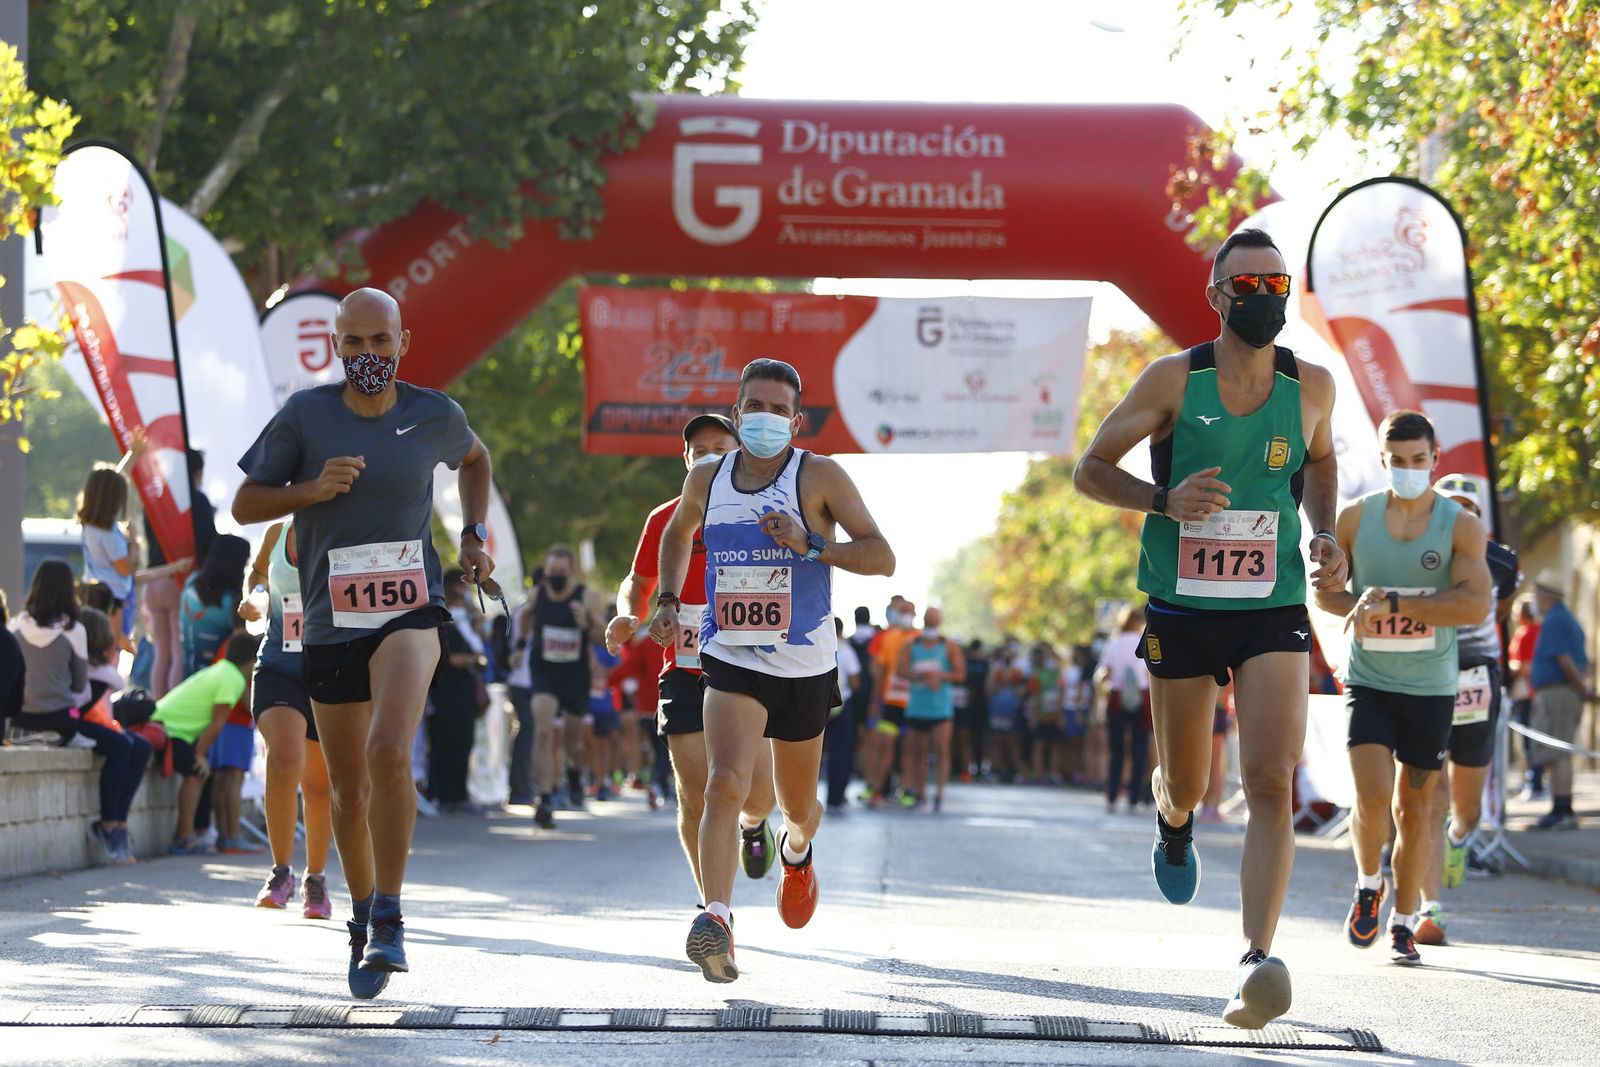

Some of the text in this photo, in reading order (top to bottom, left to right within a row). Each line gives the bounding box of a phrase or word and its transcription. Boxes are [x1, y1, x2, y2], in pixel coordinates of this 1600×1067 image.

[781, 119, 1006, 163] Diputación
[777, 166, 1006, 210] de Granada
[777, 223, 915, 248] Avanzamos
[713, 547, 794, 564] TODO SUMA
[1192, 547, 1265, 577] 1173
[343, 579, 417, 608] 1150
[721, 601, 781, 626] 1086
[1376, 616, 1427, 635] 1124
